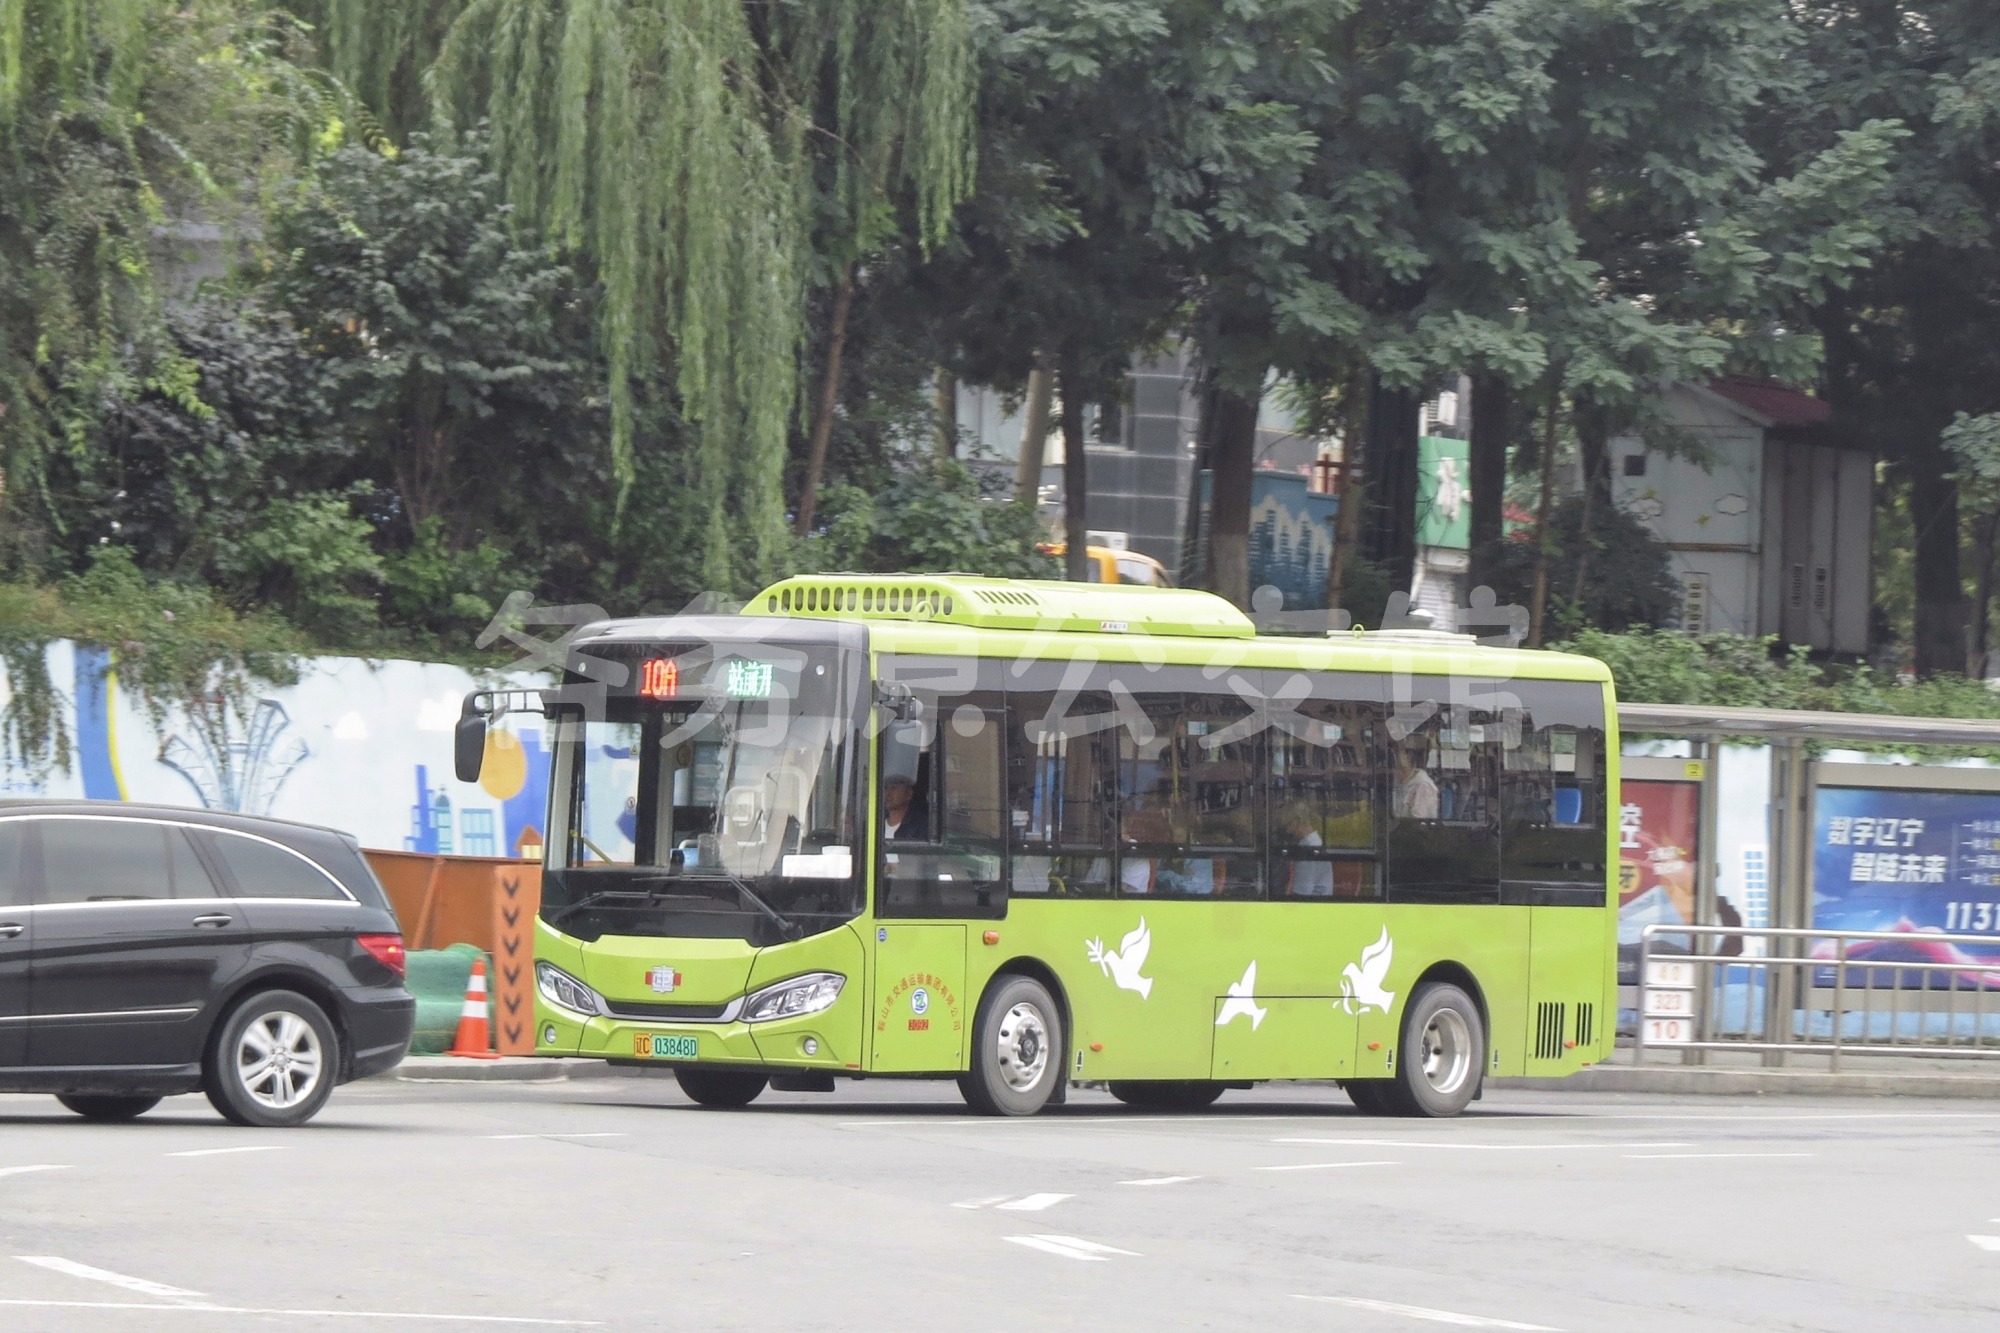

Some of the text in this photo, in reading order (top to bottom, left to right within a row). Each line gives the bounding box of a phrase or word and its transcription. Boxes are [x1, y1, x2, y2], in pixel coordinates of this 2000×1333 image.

[641, 659, 676, 696] 10A
[1828, 816, 1925, 847] 数字辽宁
[1652, 1021, 1680, 1039] 10
[654, 1037, 697, 1056] 03848D
